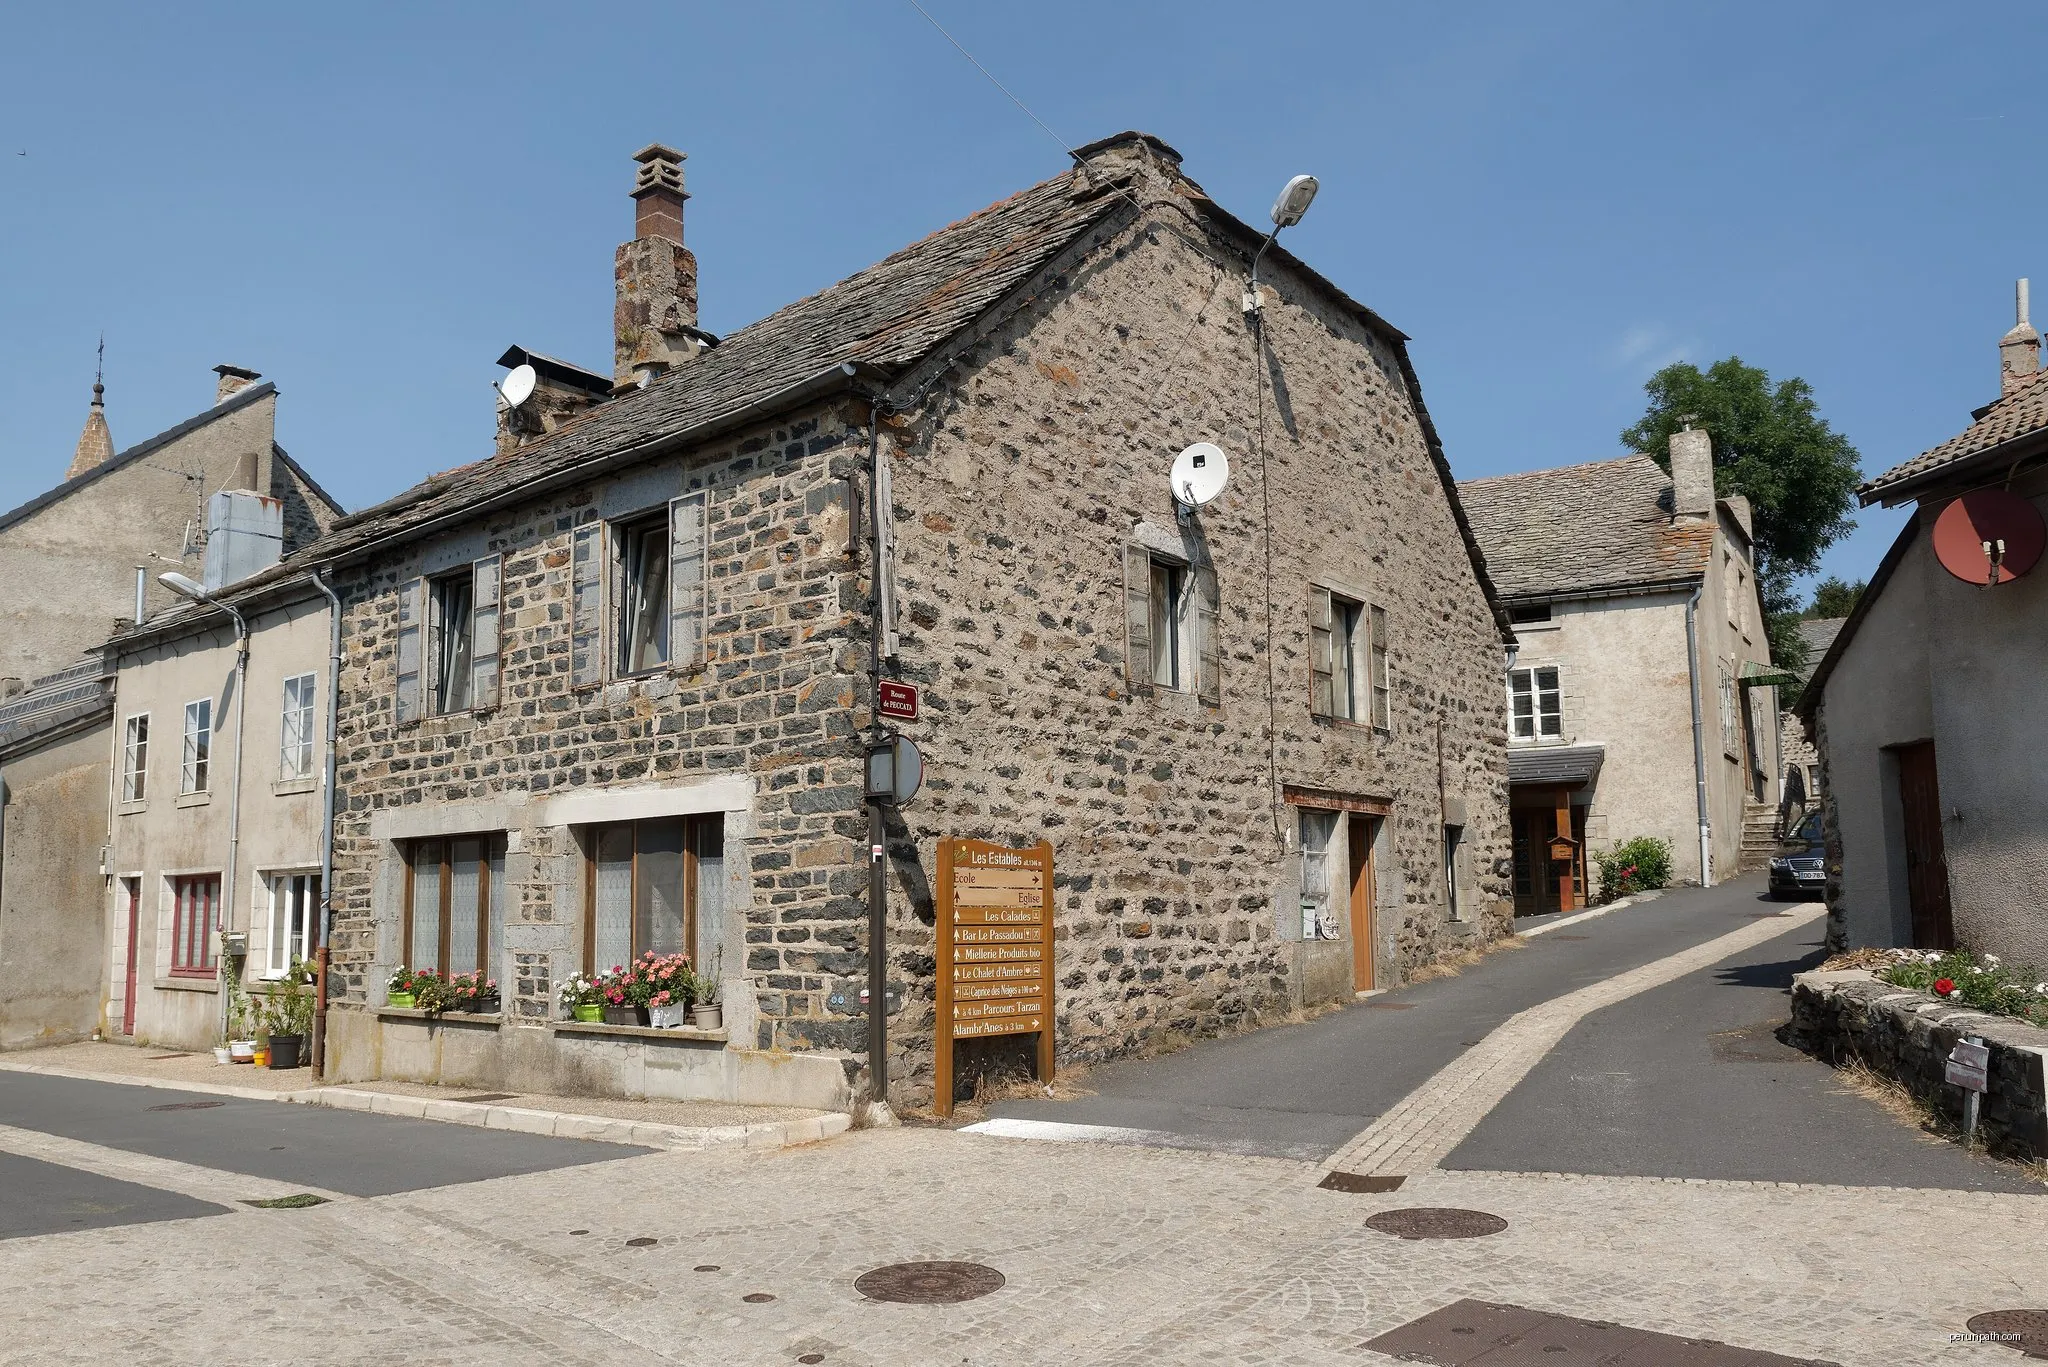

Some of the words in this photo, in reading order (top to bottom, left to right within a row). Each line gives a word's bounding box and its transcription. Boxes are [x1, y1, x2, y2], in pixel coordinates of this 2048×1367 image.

[890, 690, 906, 699] Route
[890, 701, 912, 711] PECCATA
[971, 850, 986, 865] Les
[988, 851, 1022, 866] Estables
[953, 872, 976, 884] Ecole
[1018, 892, 1041, 905] Eglise
[985, 910, 999, 922] Les
[1001, 910, 1031, 922] Calades
[962, 929, 976, 941] Bar
[978, 929, 988, 940] Le
[989, 928, 1023, 940] Passadou
[965, 948, 997, 960] Miellerie
[998, 946, 1028, 959] Produits
[1029, 946, 1041, 958] bio
[962, 967, 971, 979] Le
[972, 966, 995, 979] Chalet
[996, 965, 1023, 977] d'Ambre
[970, 985, 991, 999] Caprice
[991, 984, 1000, 996] des
[962, 1008, 966, 1016] à
[967, 1008, 972, 1016] 4
[973, 1007, 982, 1016] km
[983, 1003, 1015, 1015] Parcours
[1016, 1001, 1041, 1013] Tarzan
[953, 1021, 1003, 1035] Alambr'Anes
[1004, 1023, 1009, 1031] à
[1010, 1022, 1015, 1031] 3
[1015, 1022, 1025, 1031] km
